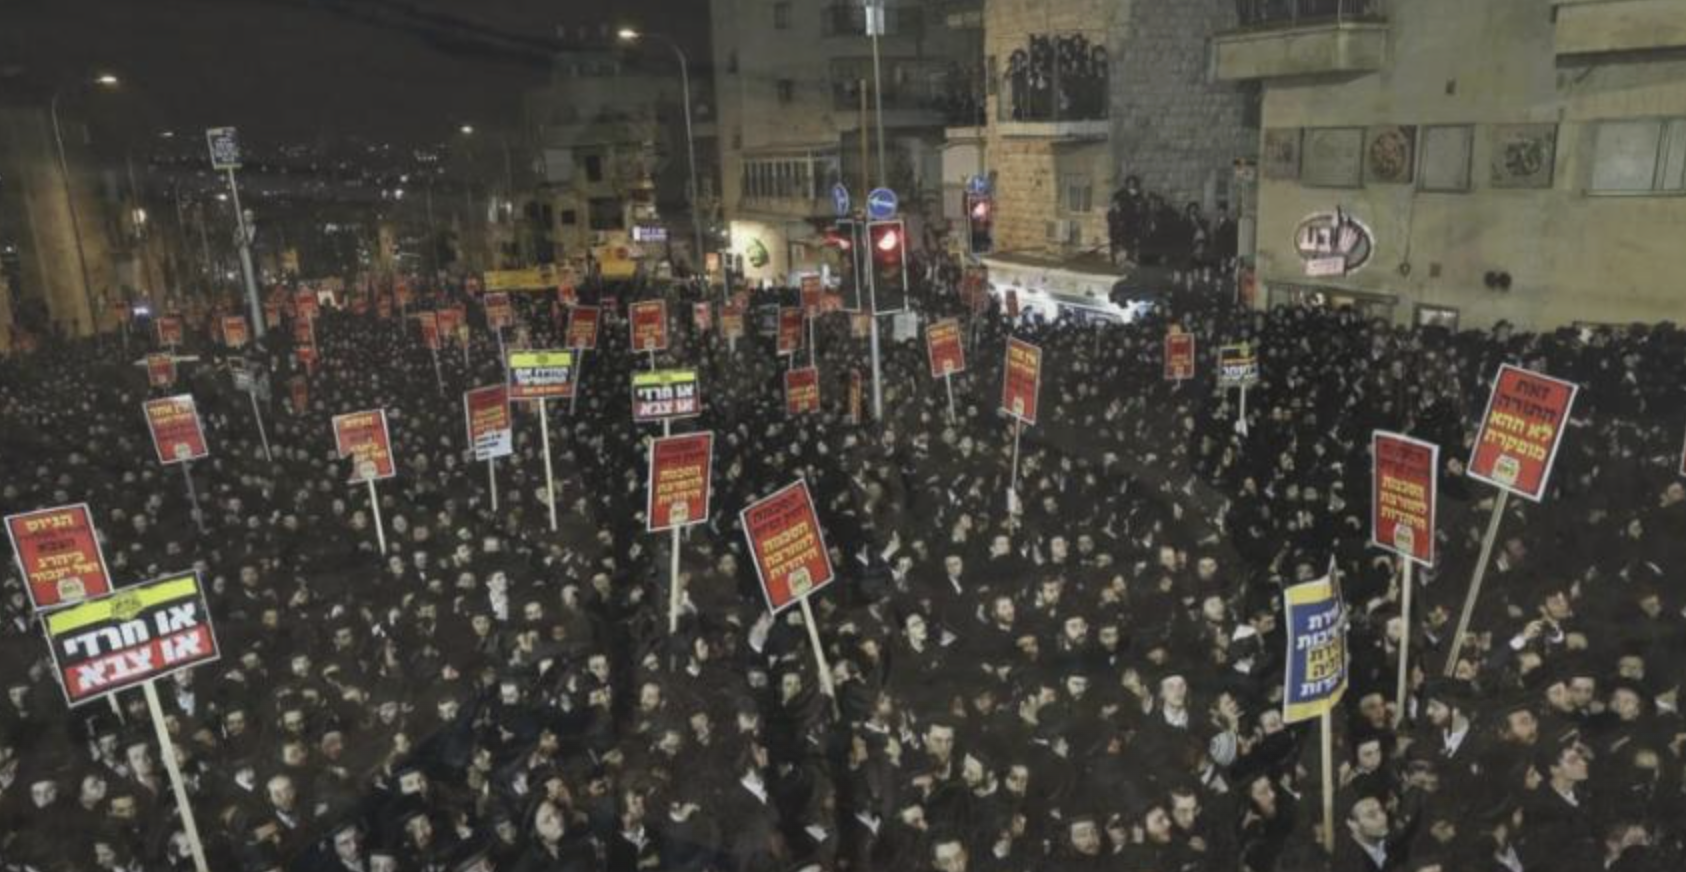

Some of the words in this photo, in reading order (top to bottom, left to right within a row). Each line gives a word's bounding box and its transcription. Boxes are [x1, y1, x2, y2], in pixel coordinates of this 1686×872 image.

[637, 386, 672, 401] חרדי
[676, 384, 694, 399] או
[1516, 379, 1553, 398] זאת
[640, 401, 673, 416] צבא
[676, 399, 694, 414] או
[1496, 394, 1557, 422] התורה
[1490, 410, 1525, 434] תהא
[1528, 422, 1553, 441] לא
[26, 514, 73, 532] הגיוס
[154, 602, 196, 637] או
[63, 619, 149, 657] חרדי
[160, 629, 201, 666] או
[77, 648, 153, 690] צבא
